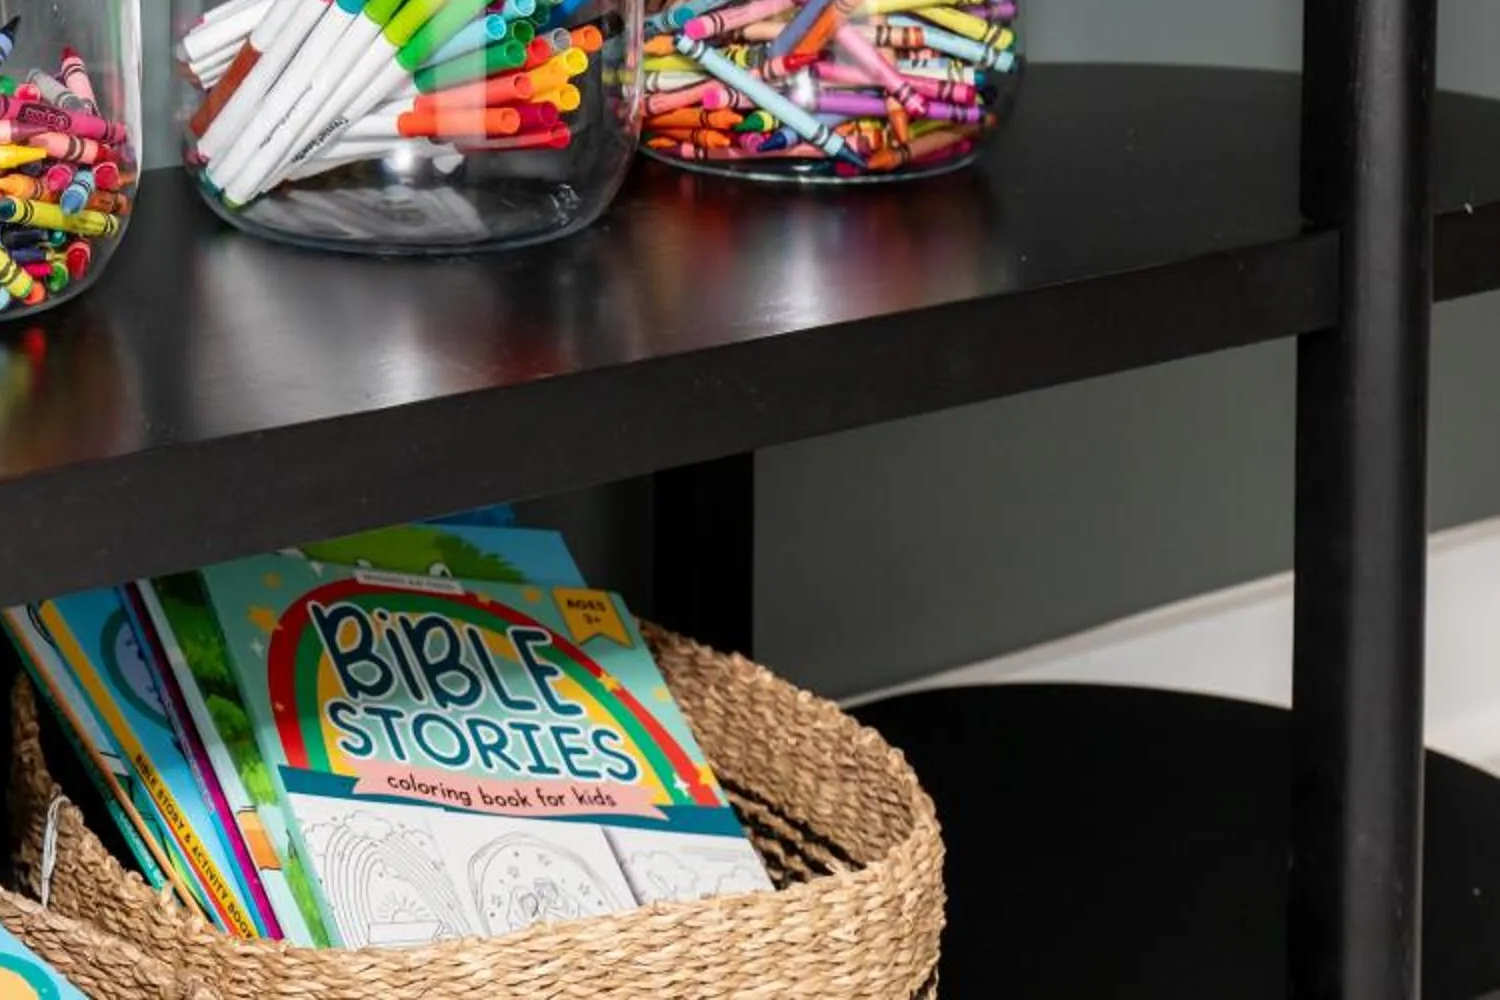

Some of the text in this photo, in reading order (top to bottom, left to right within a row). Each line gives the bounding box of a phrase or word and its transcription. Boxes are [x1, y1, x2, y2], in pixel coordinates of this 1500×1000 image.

[327, 700, 640, 783] STORIES
[386, 774, 618, 809] coloring book for kids
